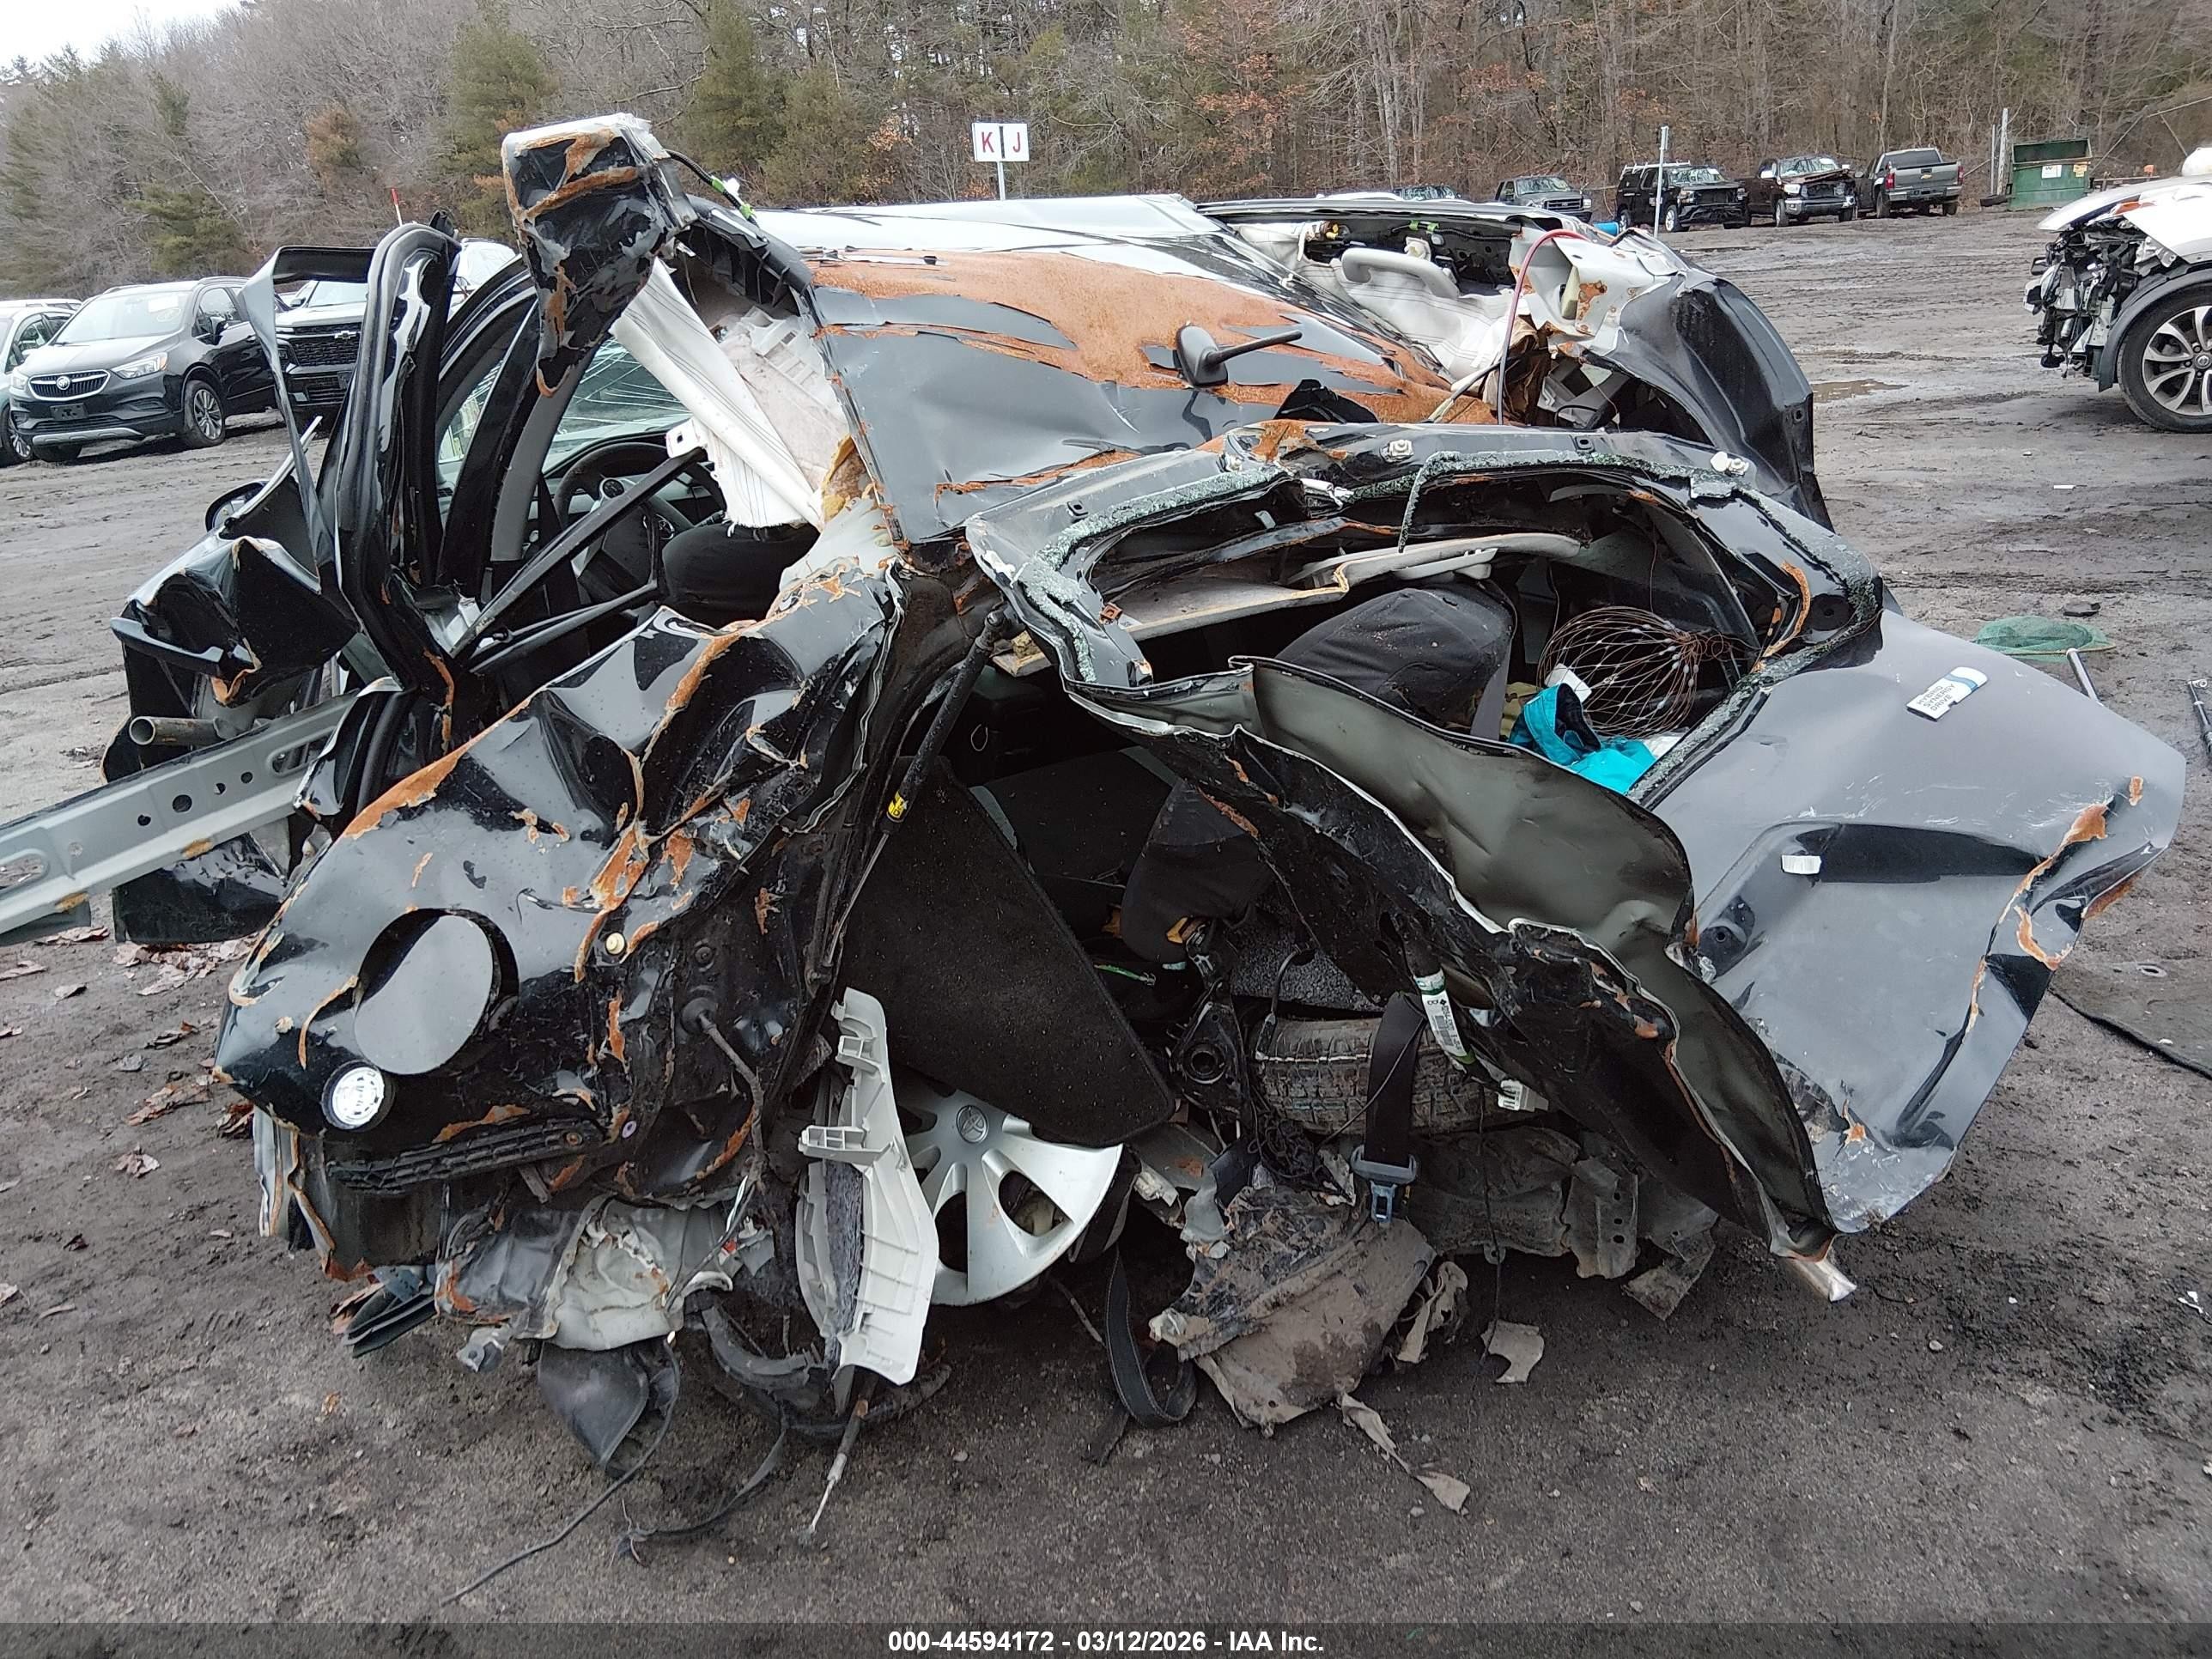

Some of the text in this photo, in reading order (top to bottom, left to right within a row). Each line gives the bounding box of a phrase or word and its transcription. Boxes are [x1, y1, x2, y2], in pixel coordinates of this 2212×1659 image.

[981, 131, 1021, 153] K J
[1923, 684, 1955, 708] SYNERGY
[1930, 694, 1953, 712] DRIVE
